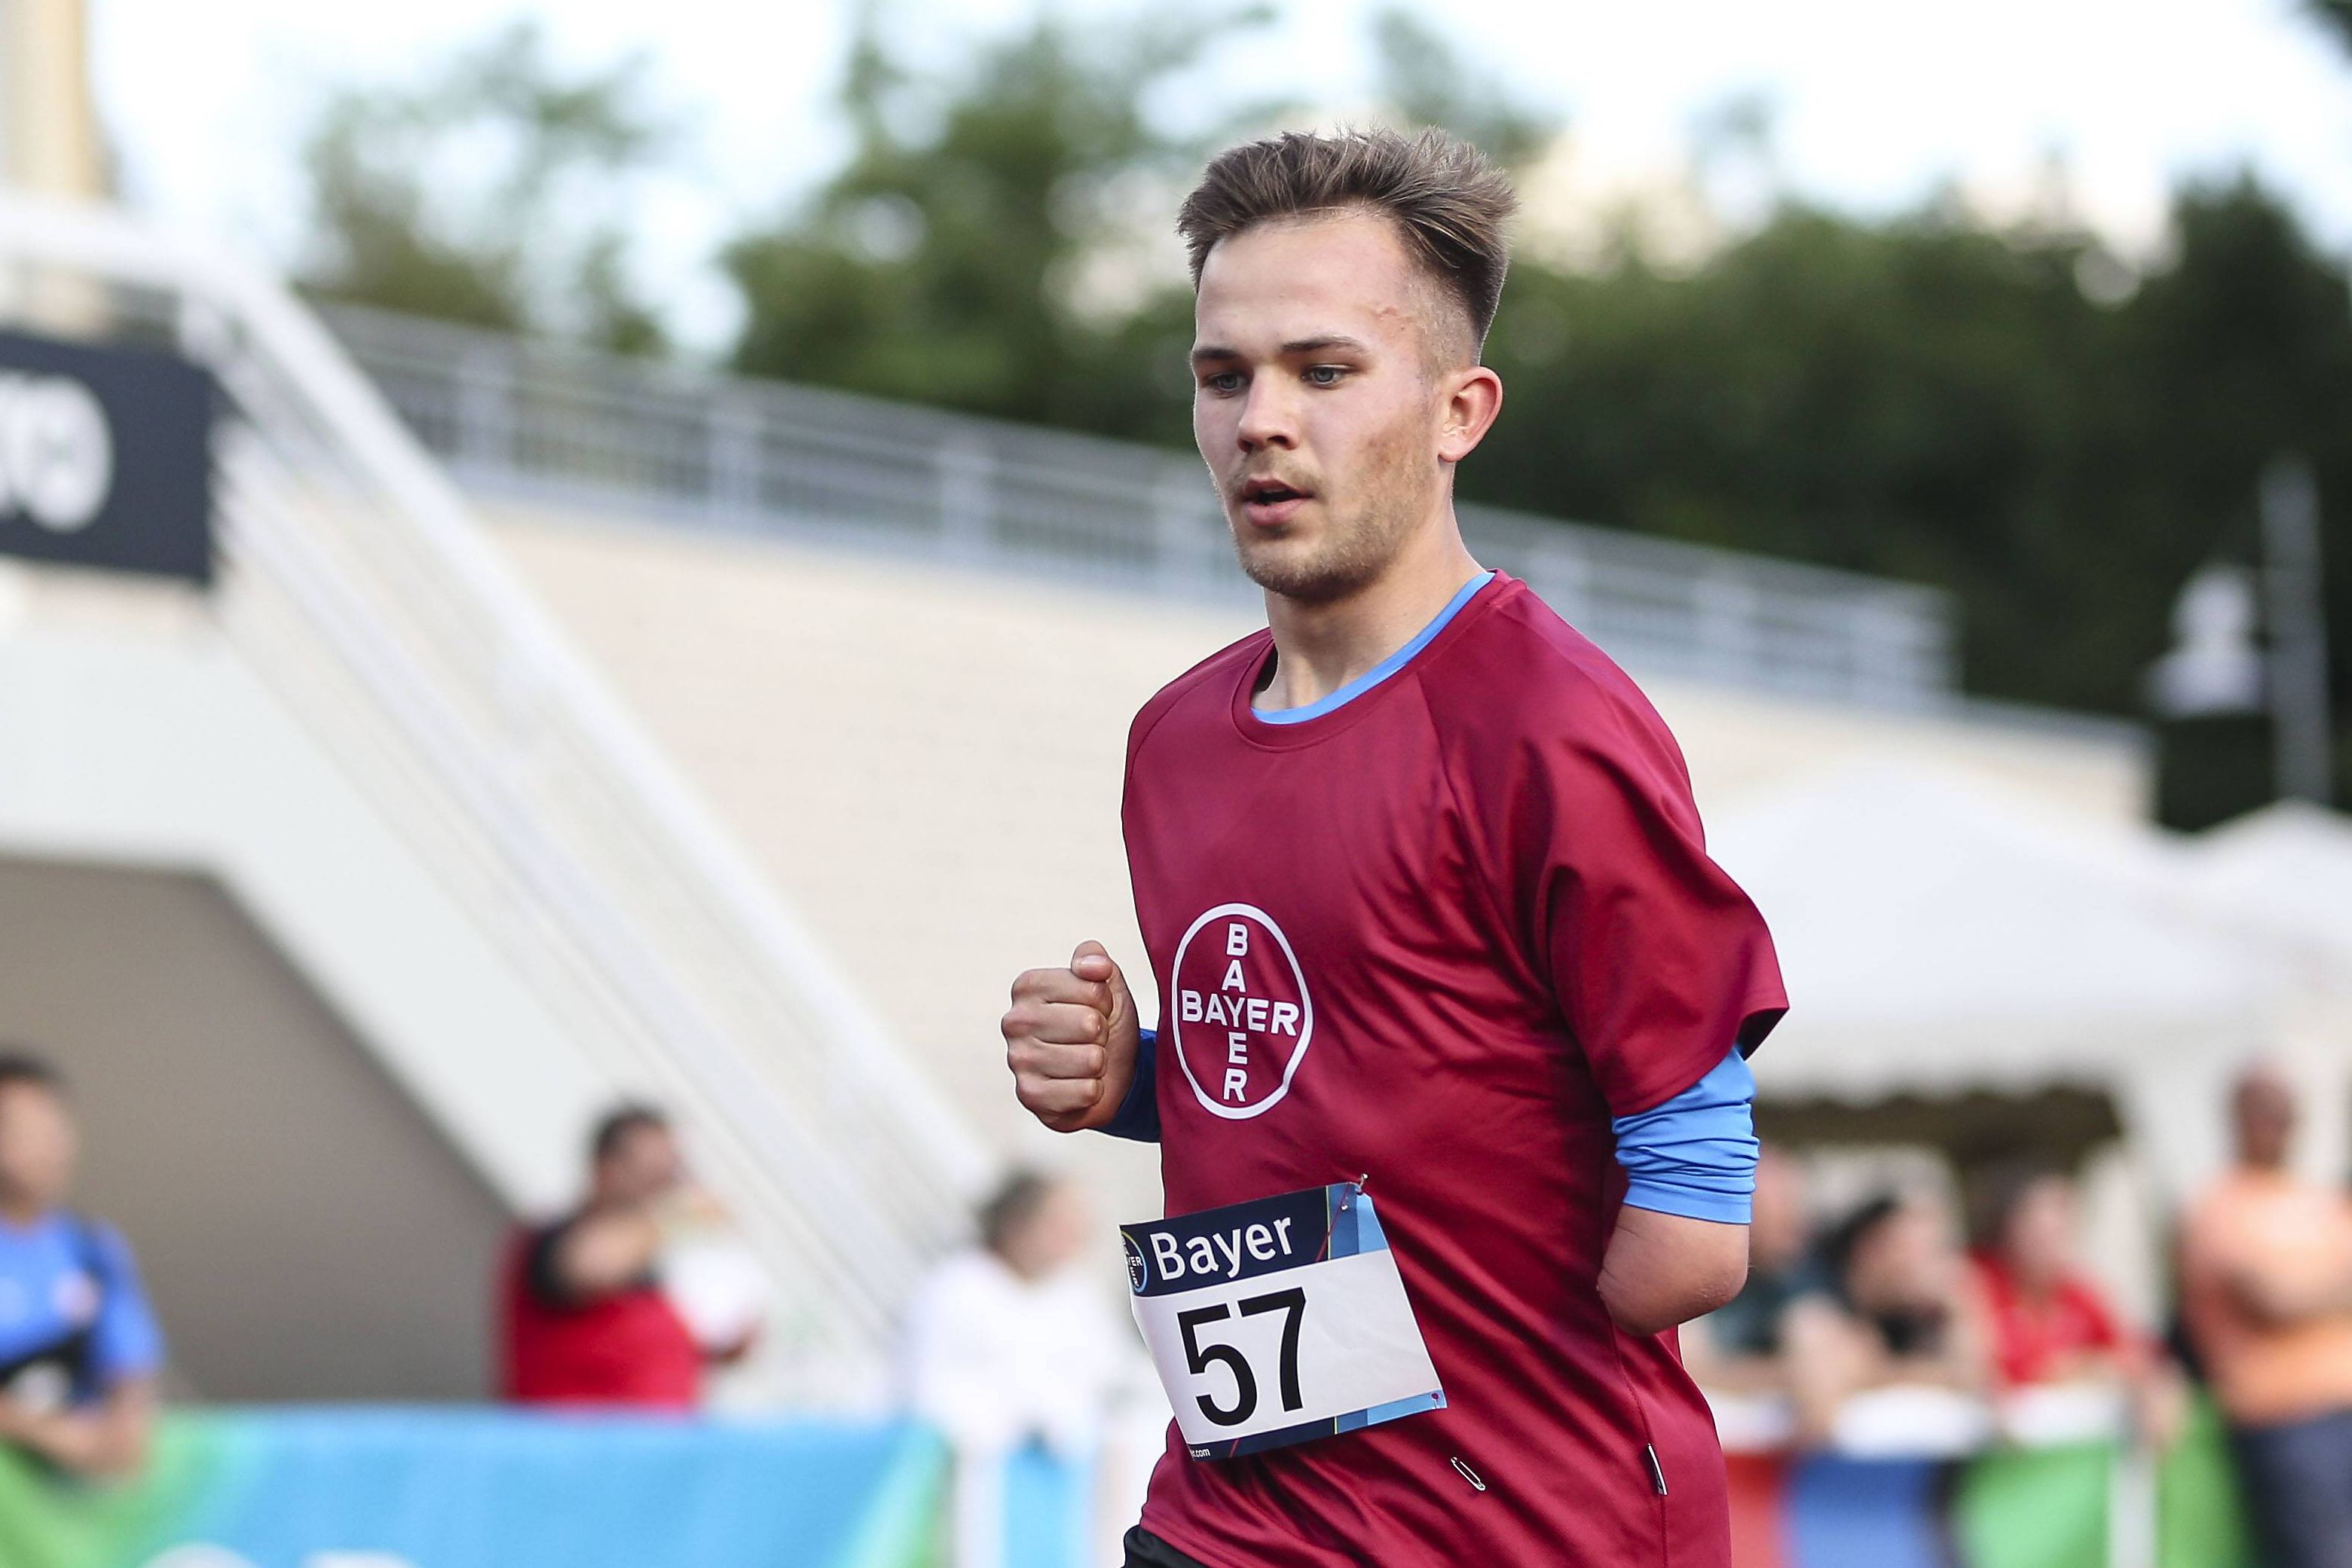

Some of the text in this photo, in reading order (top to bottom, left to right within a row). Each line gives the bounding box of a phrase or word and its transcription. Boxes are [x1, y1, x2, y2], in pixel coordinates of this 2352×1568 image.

[1181, 989, 1300, 1036] BAYER
[1221, 923, 1248, 1102] BAYER
[1149, 1216, 1292, 1279] Bayer
[1177, 1286, 1307, 1427] 57
